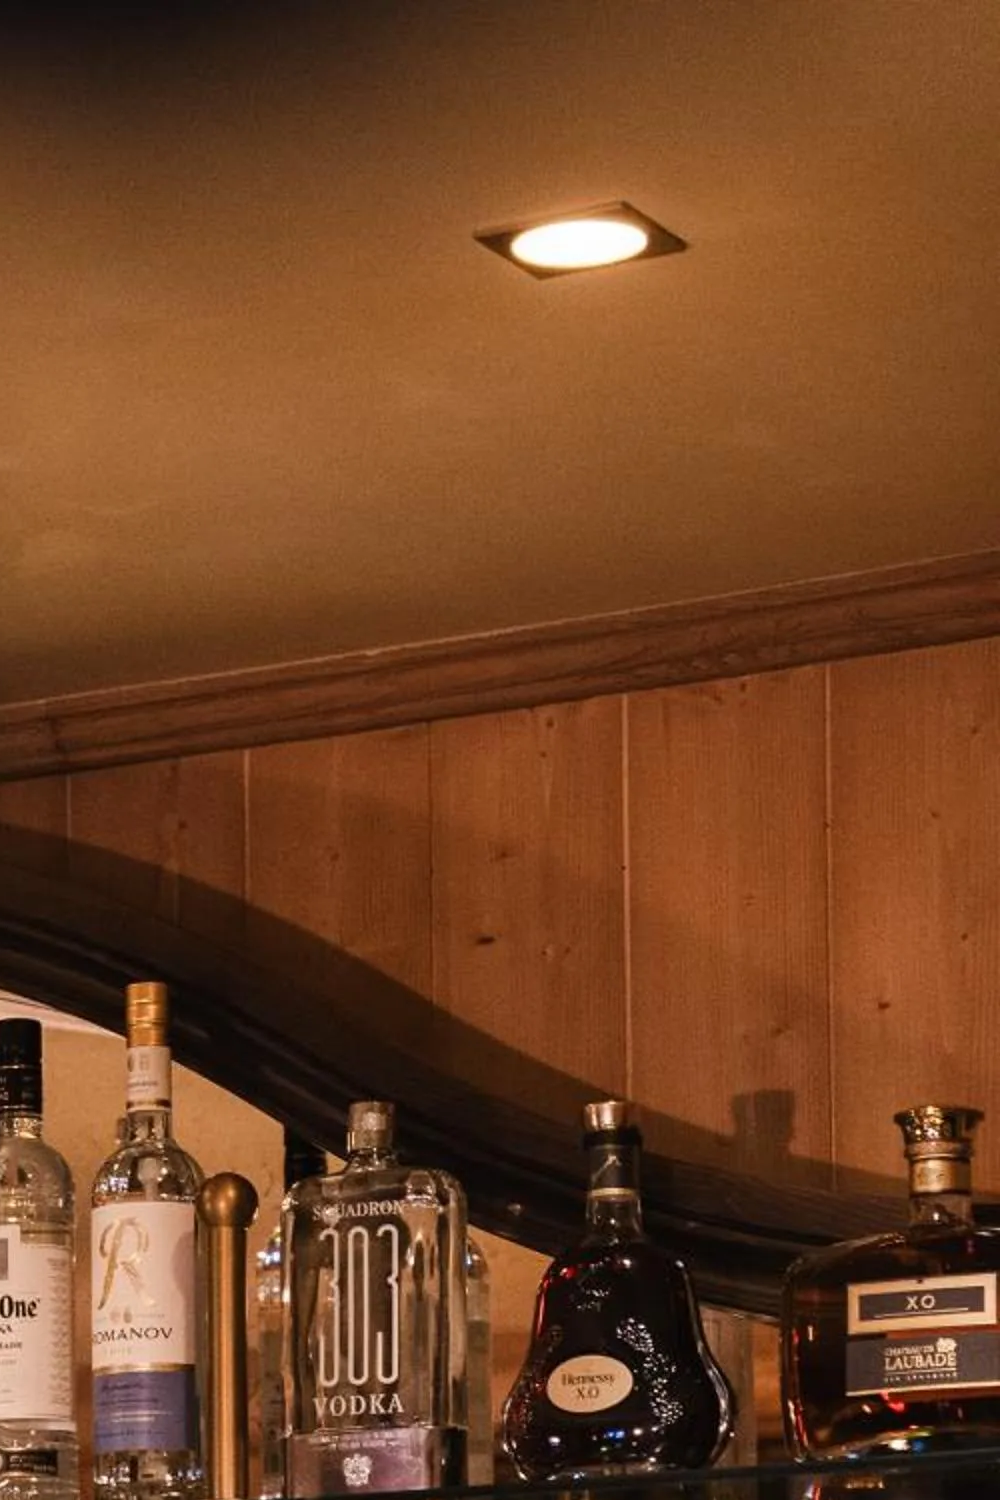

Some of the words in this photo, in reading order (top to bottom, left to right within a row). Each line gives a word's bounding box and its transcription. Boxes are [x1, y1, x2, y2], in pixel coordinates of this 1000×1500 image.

[0, 1295, 38, 1319] One
[319, 1223, 399, 1388] 303
[905, 1294, 937, 1311] XO
[91, 1327, 174, 1346] OMANOV
[884, 1352, 957, 1371] LAUBADE
[312, 1393, 405, 1417] VODKA
